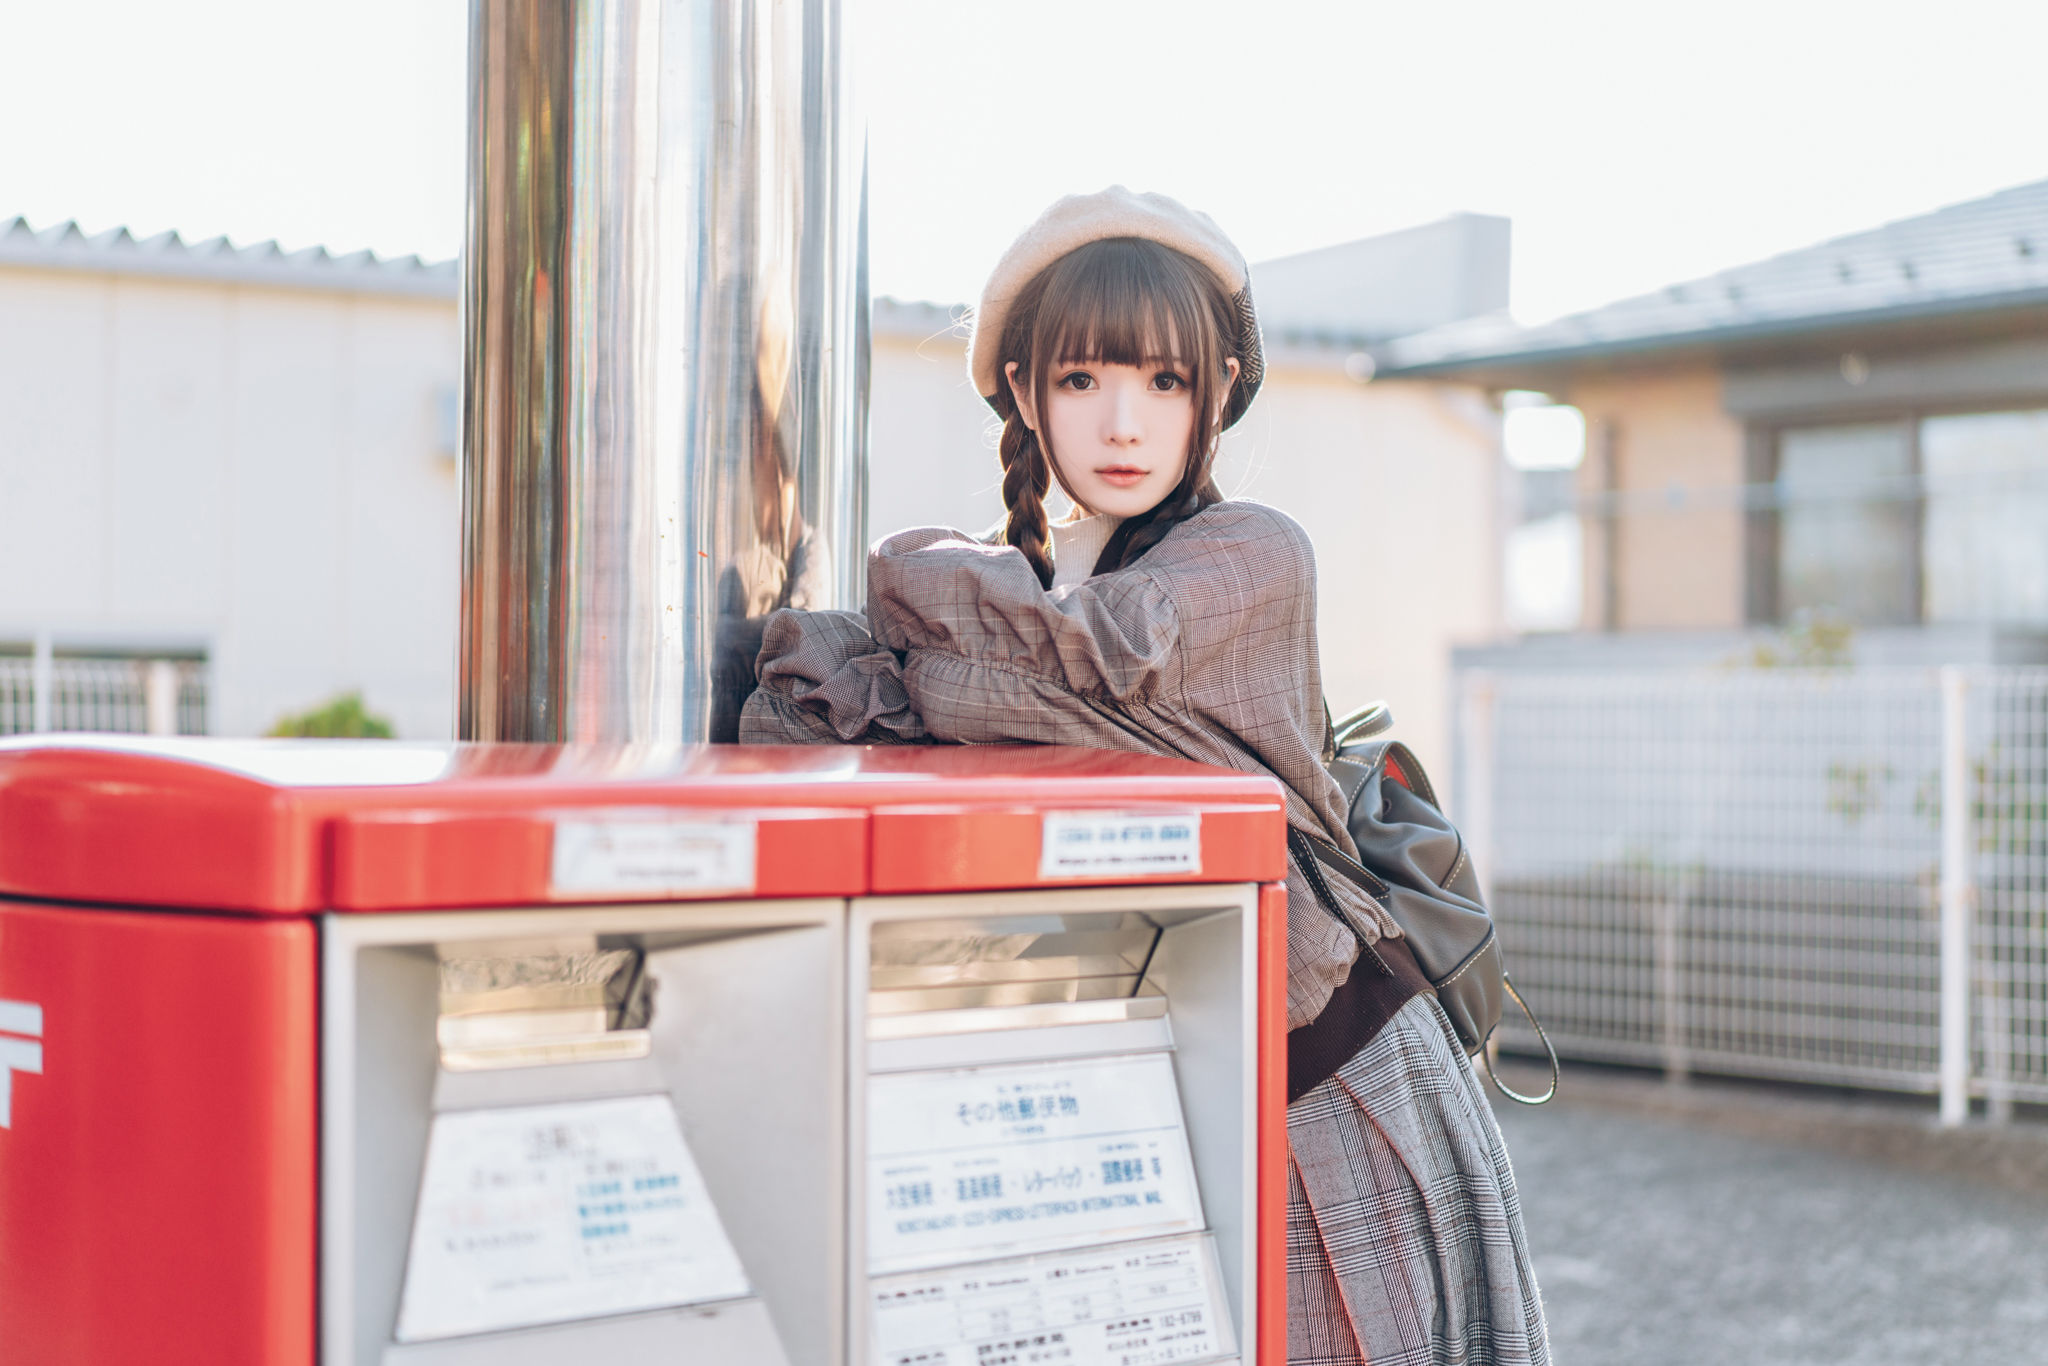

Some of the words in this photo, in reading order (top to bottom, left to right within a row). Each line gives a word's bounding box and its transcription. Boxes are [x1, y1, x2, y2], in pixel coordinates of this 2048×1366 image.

[957, 1094, 1079, 1125] その他郵便物
